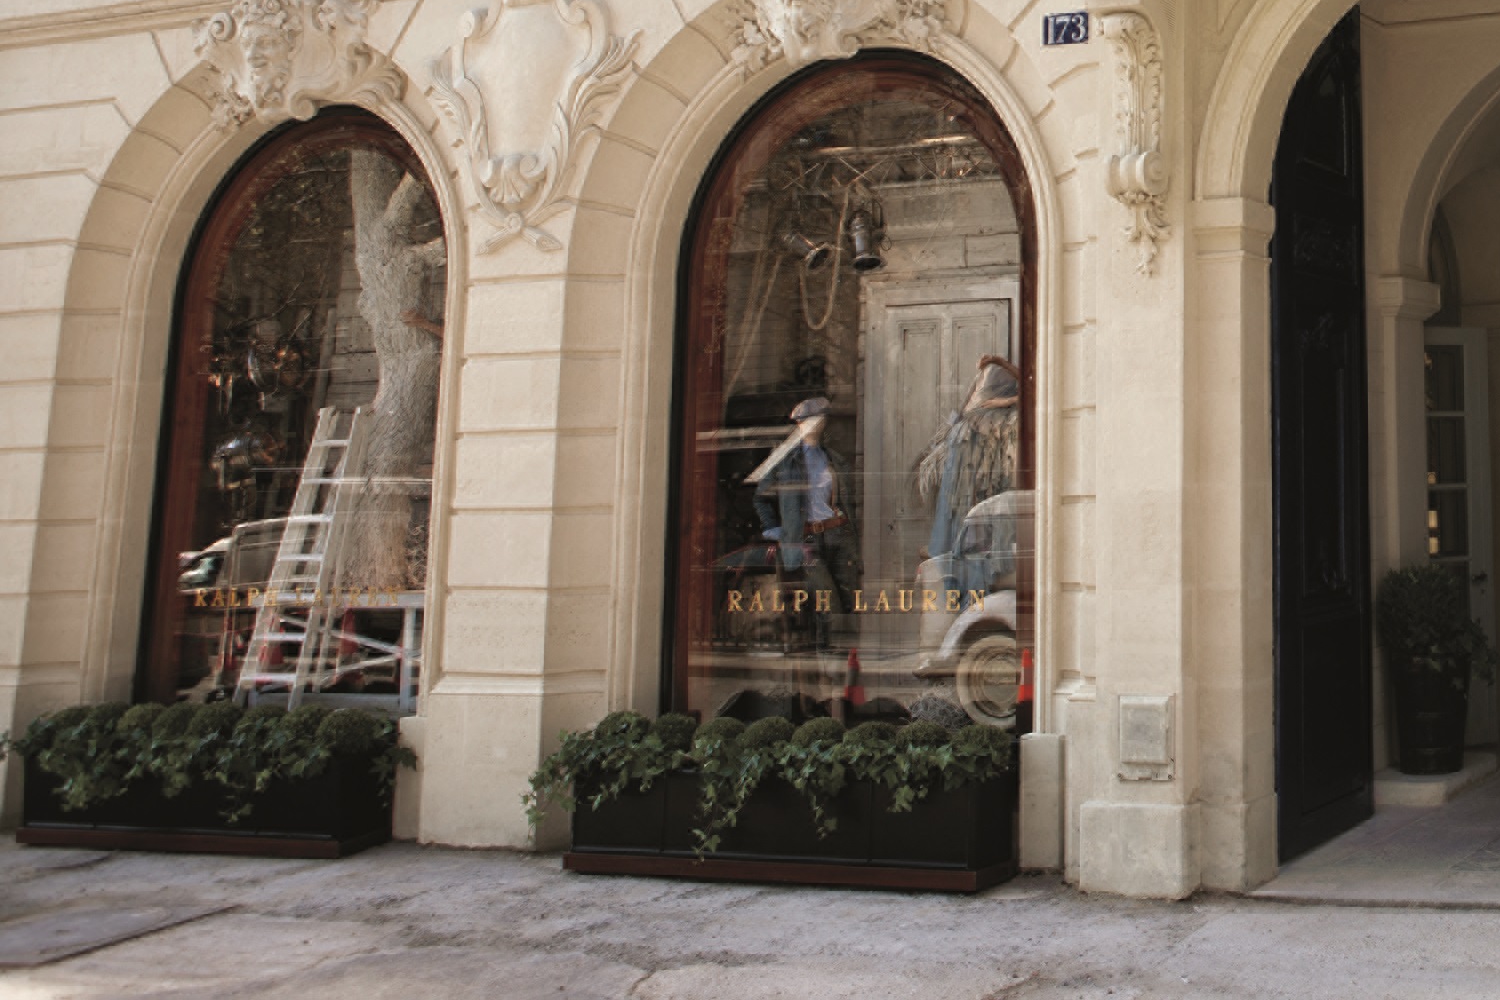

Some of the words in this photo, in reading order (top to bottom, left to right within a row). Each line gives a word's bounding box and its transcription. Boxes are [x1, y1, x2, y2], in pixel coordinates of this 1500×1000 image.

[1047, 13, 1086, 45] 173
[193, 587, 278, 607] RALPH
[727, 589, 833, 613] RALPH
[852, 589, 986, 612] LAUREN
